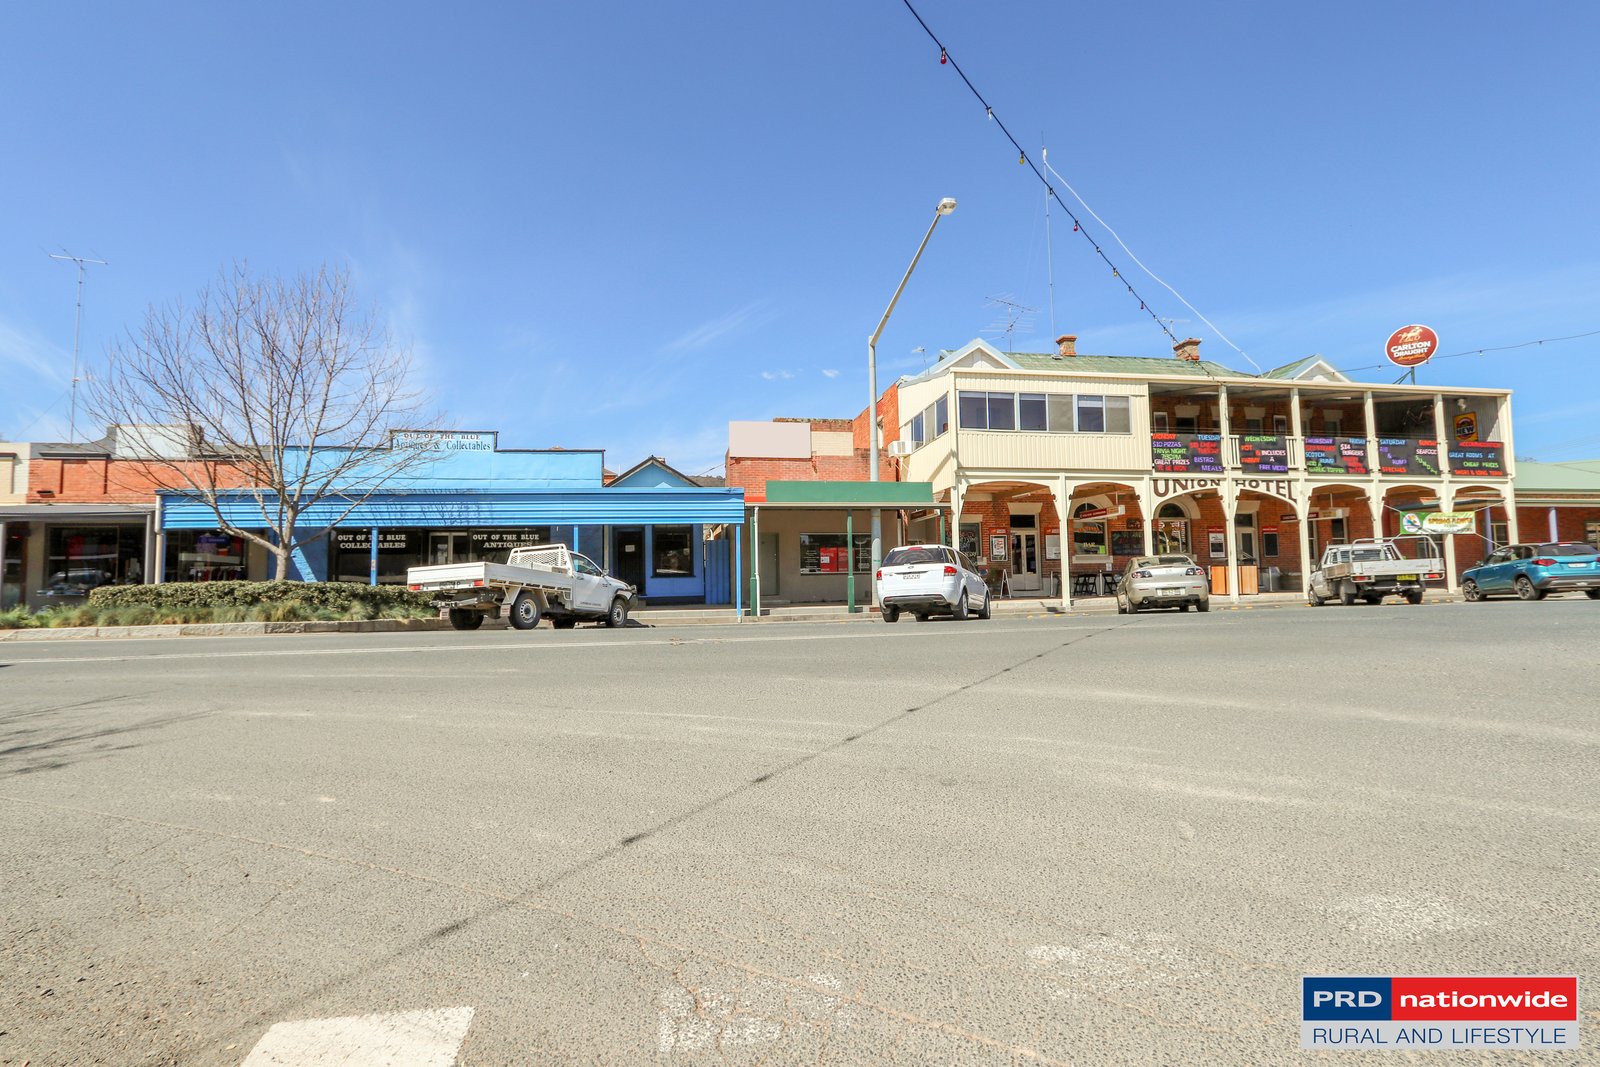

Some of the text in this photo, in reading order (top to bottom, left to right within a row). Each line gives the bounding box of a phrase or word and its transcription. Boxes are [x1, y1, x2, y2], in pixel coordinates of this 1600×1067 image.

[1391, 341, 1431, 353] CARLTON
[1393, 348, 1429, 358] DRAUGHT
[446, 440, 491, 451] Collectables
[1153, 479, 1297, 500] UNION HOTEL
